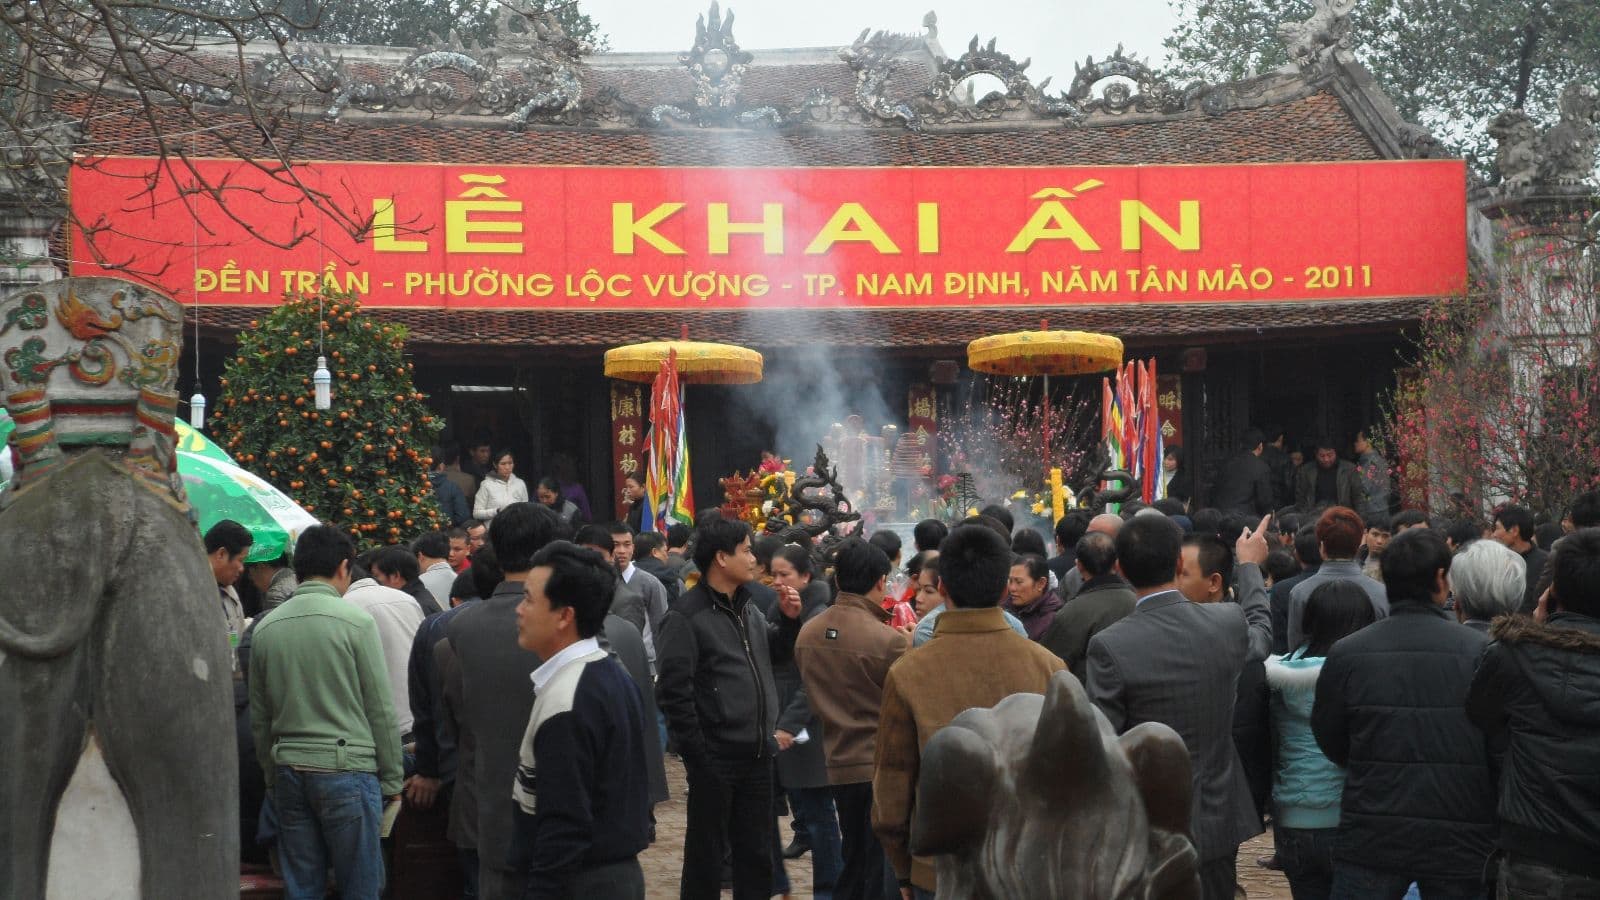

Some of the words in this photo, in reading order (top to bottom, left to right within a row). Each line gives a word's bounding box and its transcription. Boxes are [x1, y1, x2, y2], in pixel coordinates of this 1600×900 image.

[372, 173, 525, 254] LỄ
[611, 201, 940, 256] KHAI
[1006, 178, 1201, 254] ẤN
[194, 259, 269, 293] ĐỀN
[280, 261, 369, 295] TRẦN
[404, 267, 554, 298] PHƯỜNG
[565, 267, 632, 302] LỘC
[642, 270, 769, 302] VƯỢNG
[803, 273, 845, 297] TP.
[856, 273, 933, 296] NAM
[944, 271, 1030, 299] ĐỊNH,
[1041, 264, 1117, 294] NĂM
[1126, 265, 1188, 292] TÂN
[1198, 263, 1273, 292] MÃO
[1304, 264, 1372, 290] 2011
